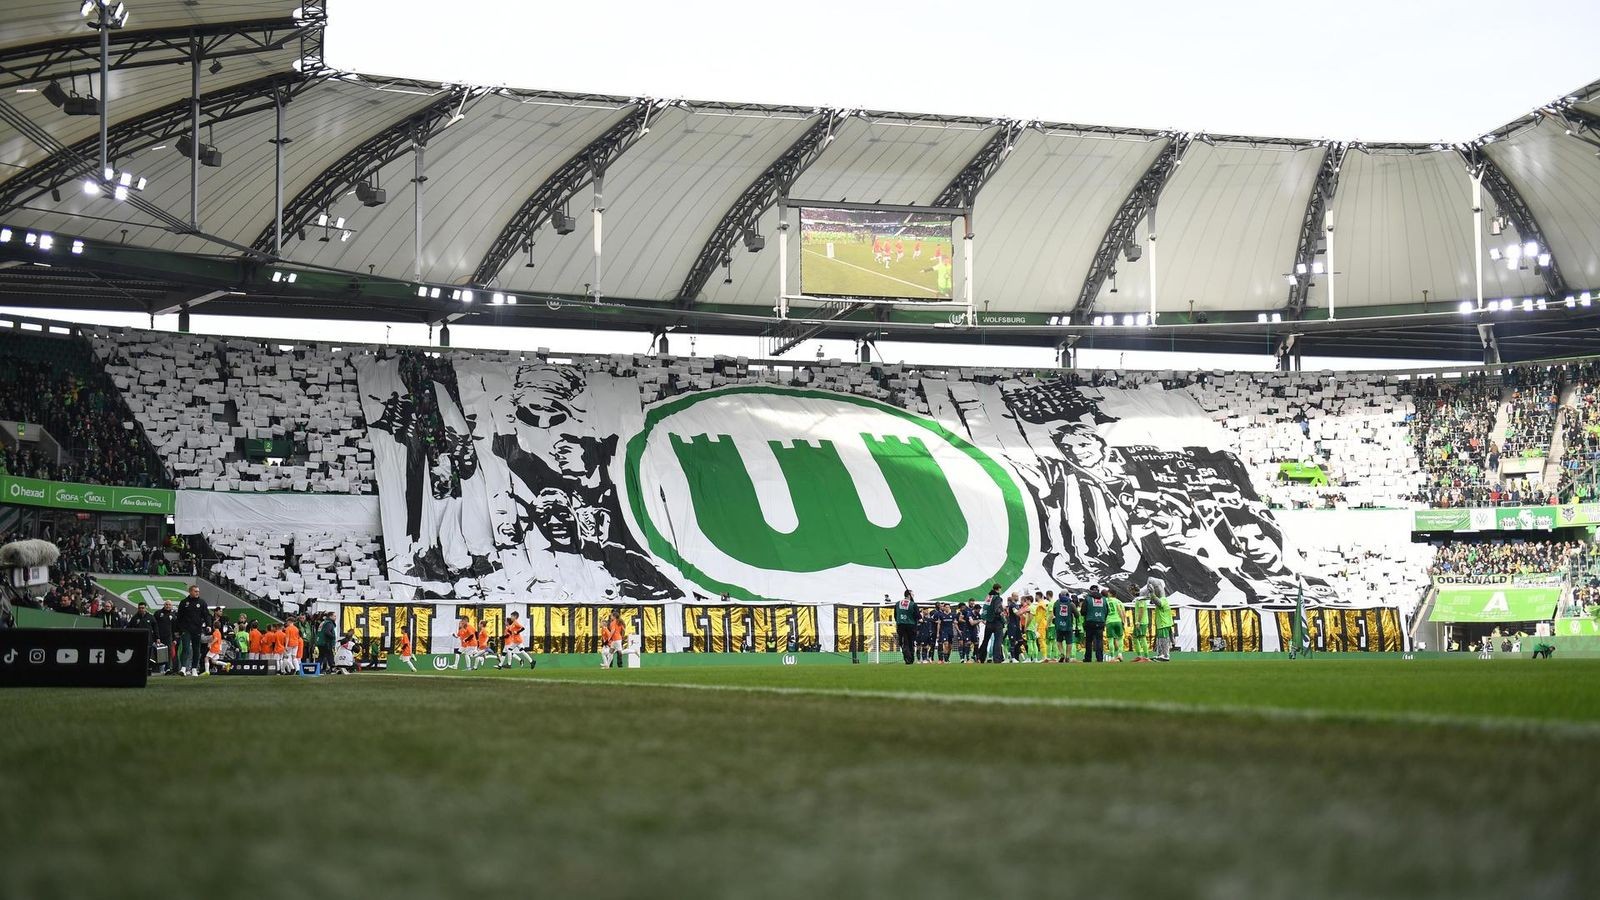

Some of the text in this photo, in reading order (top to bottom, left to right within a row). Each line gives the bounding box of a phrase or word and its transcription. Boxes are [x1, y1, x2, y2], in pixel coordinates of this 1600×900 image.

[982, 316, 1026, 324] WOLFSBURG
[20, 486, 45, 498] hexad
[1437, 575, 1508, 585] ODERWALD
[684, 606, 816, 653] STEHEN
